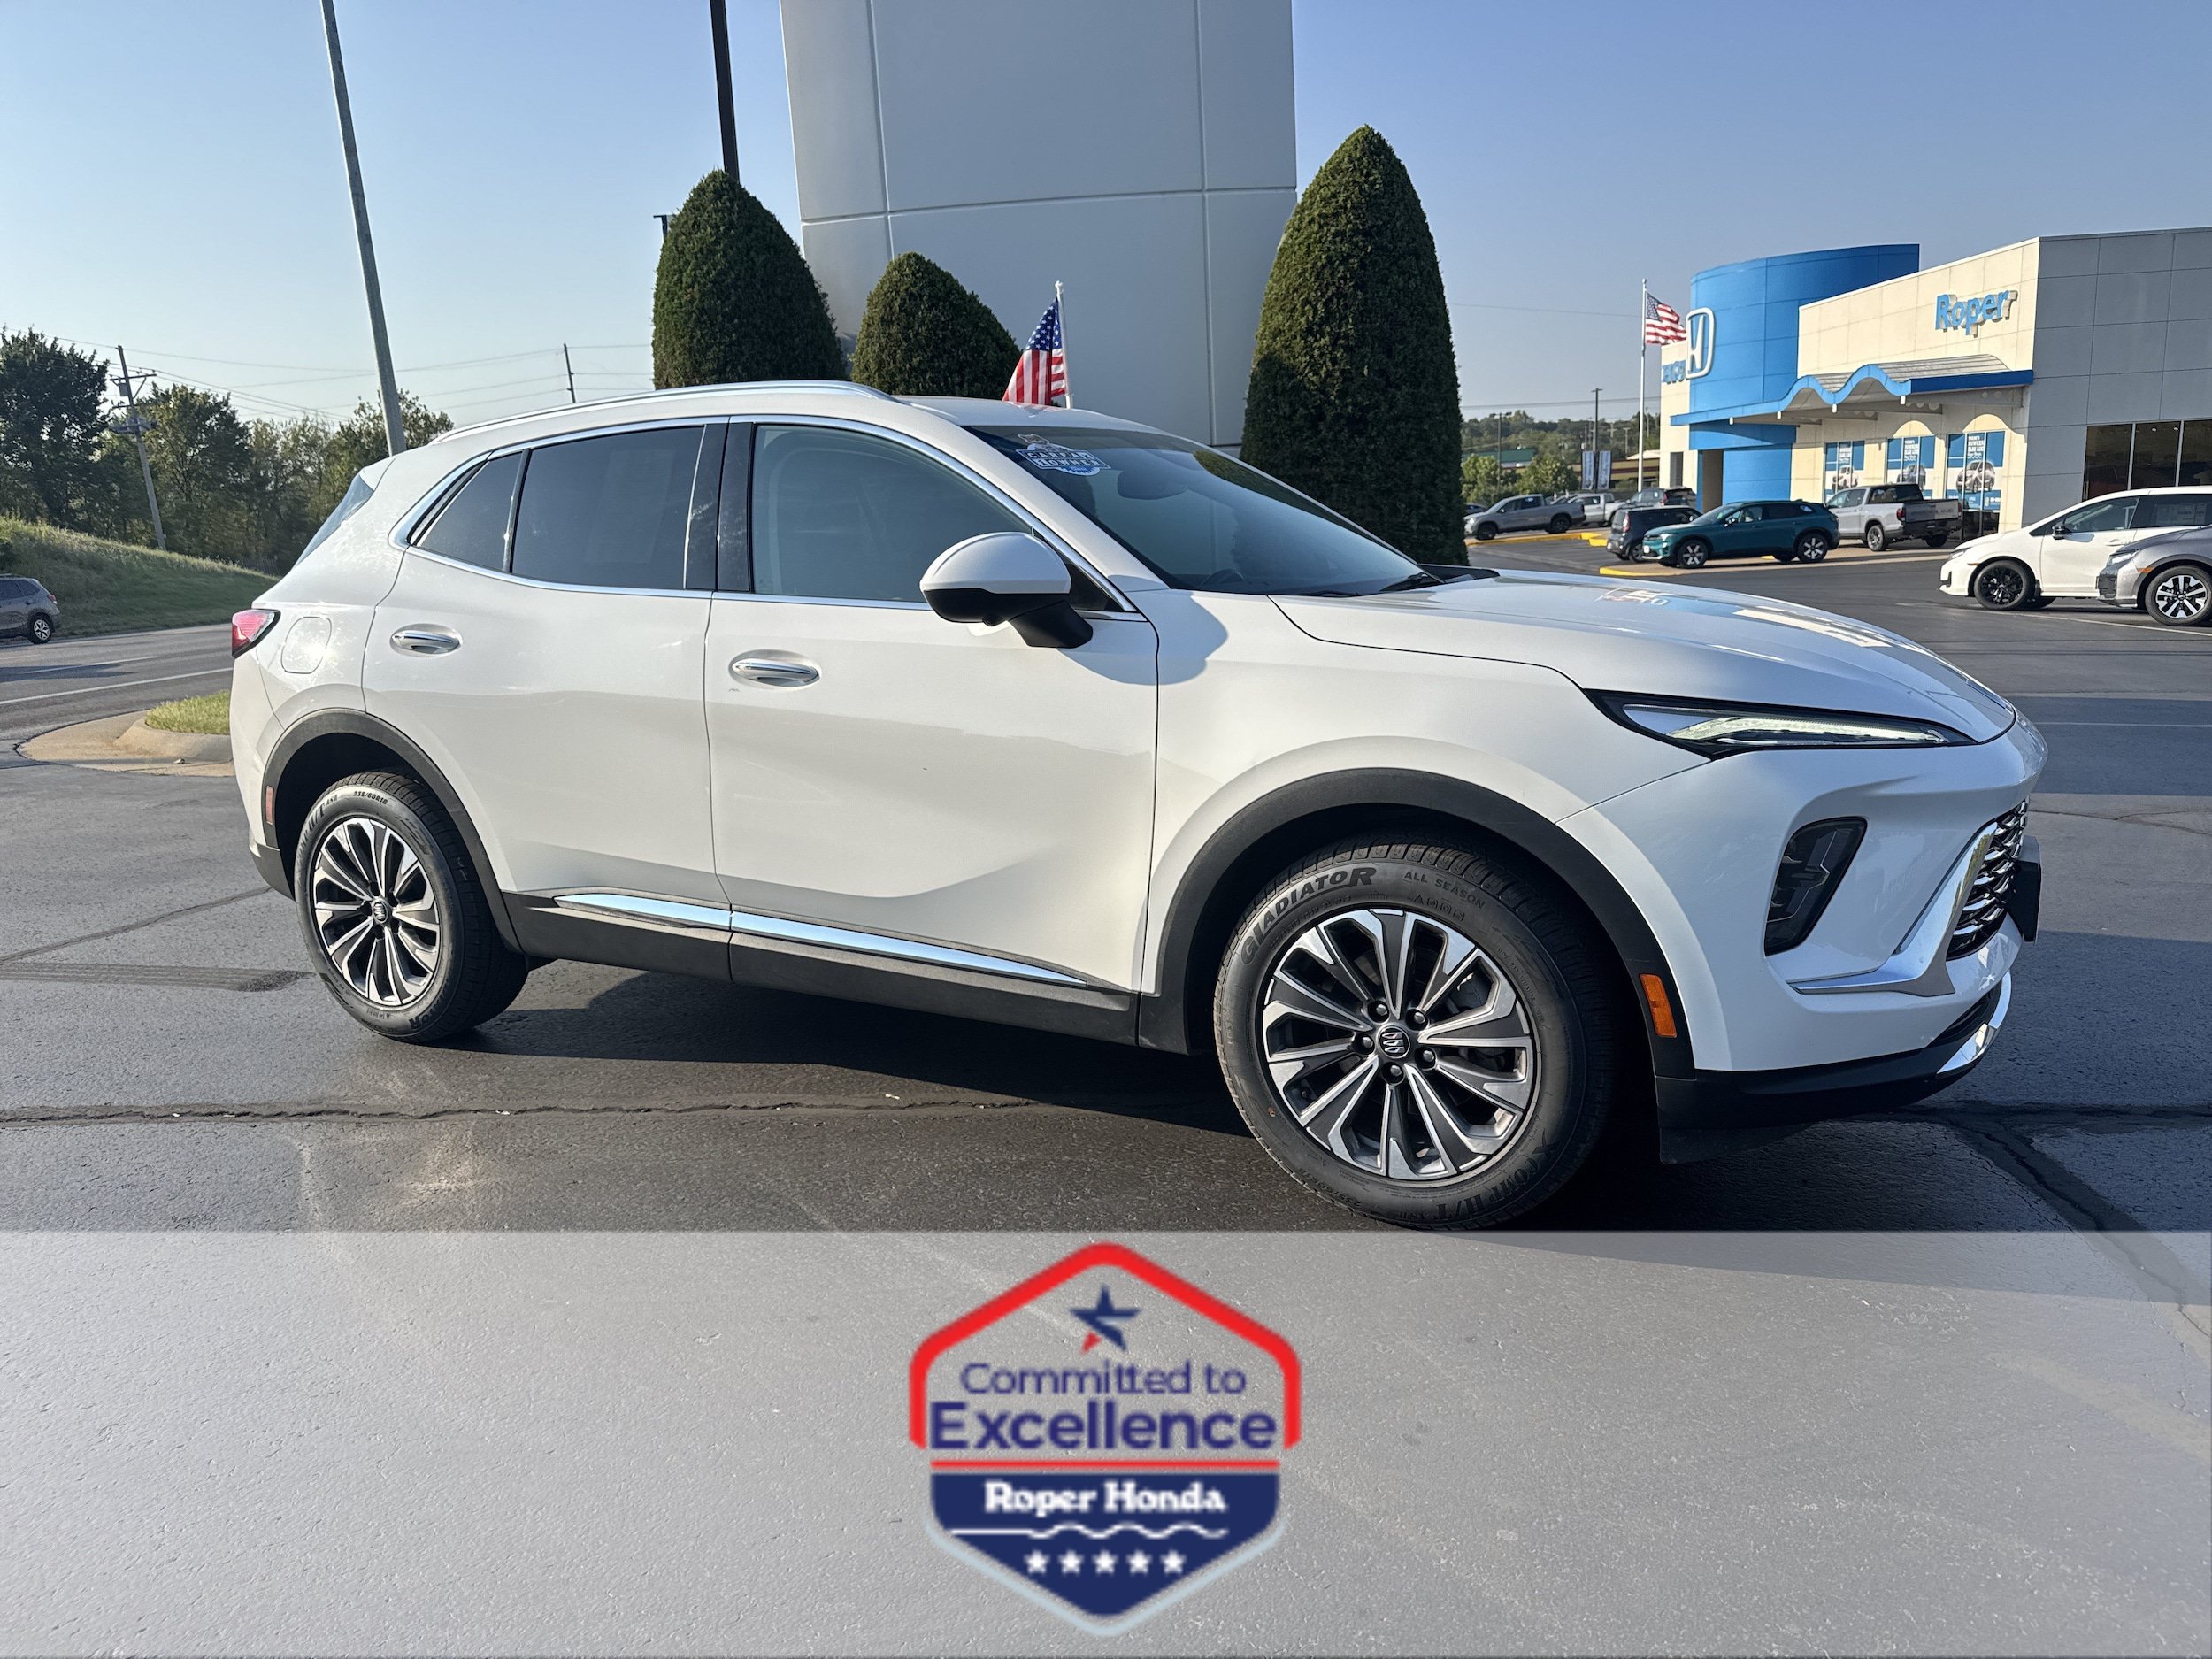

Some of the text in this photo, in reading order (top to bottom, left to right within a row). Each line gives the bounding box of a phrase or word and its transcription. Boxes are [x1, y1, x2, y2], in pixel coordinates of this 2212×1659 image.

[1935, 290, 2016, 336] Roper
[1404, 871, 1428, 883] ALL
[1434, 879, 1486, 909] SEASON
[1241, 867, 1377, 964] GLADIATOR
